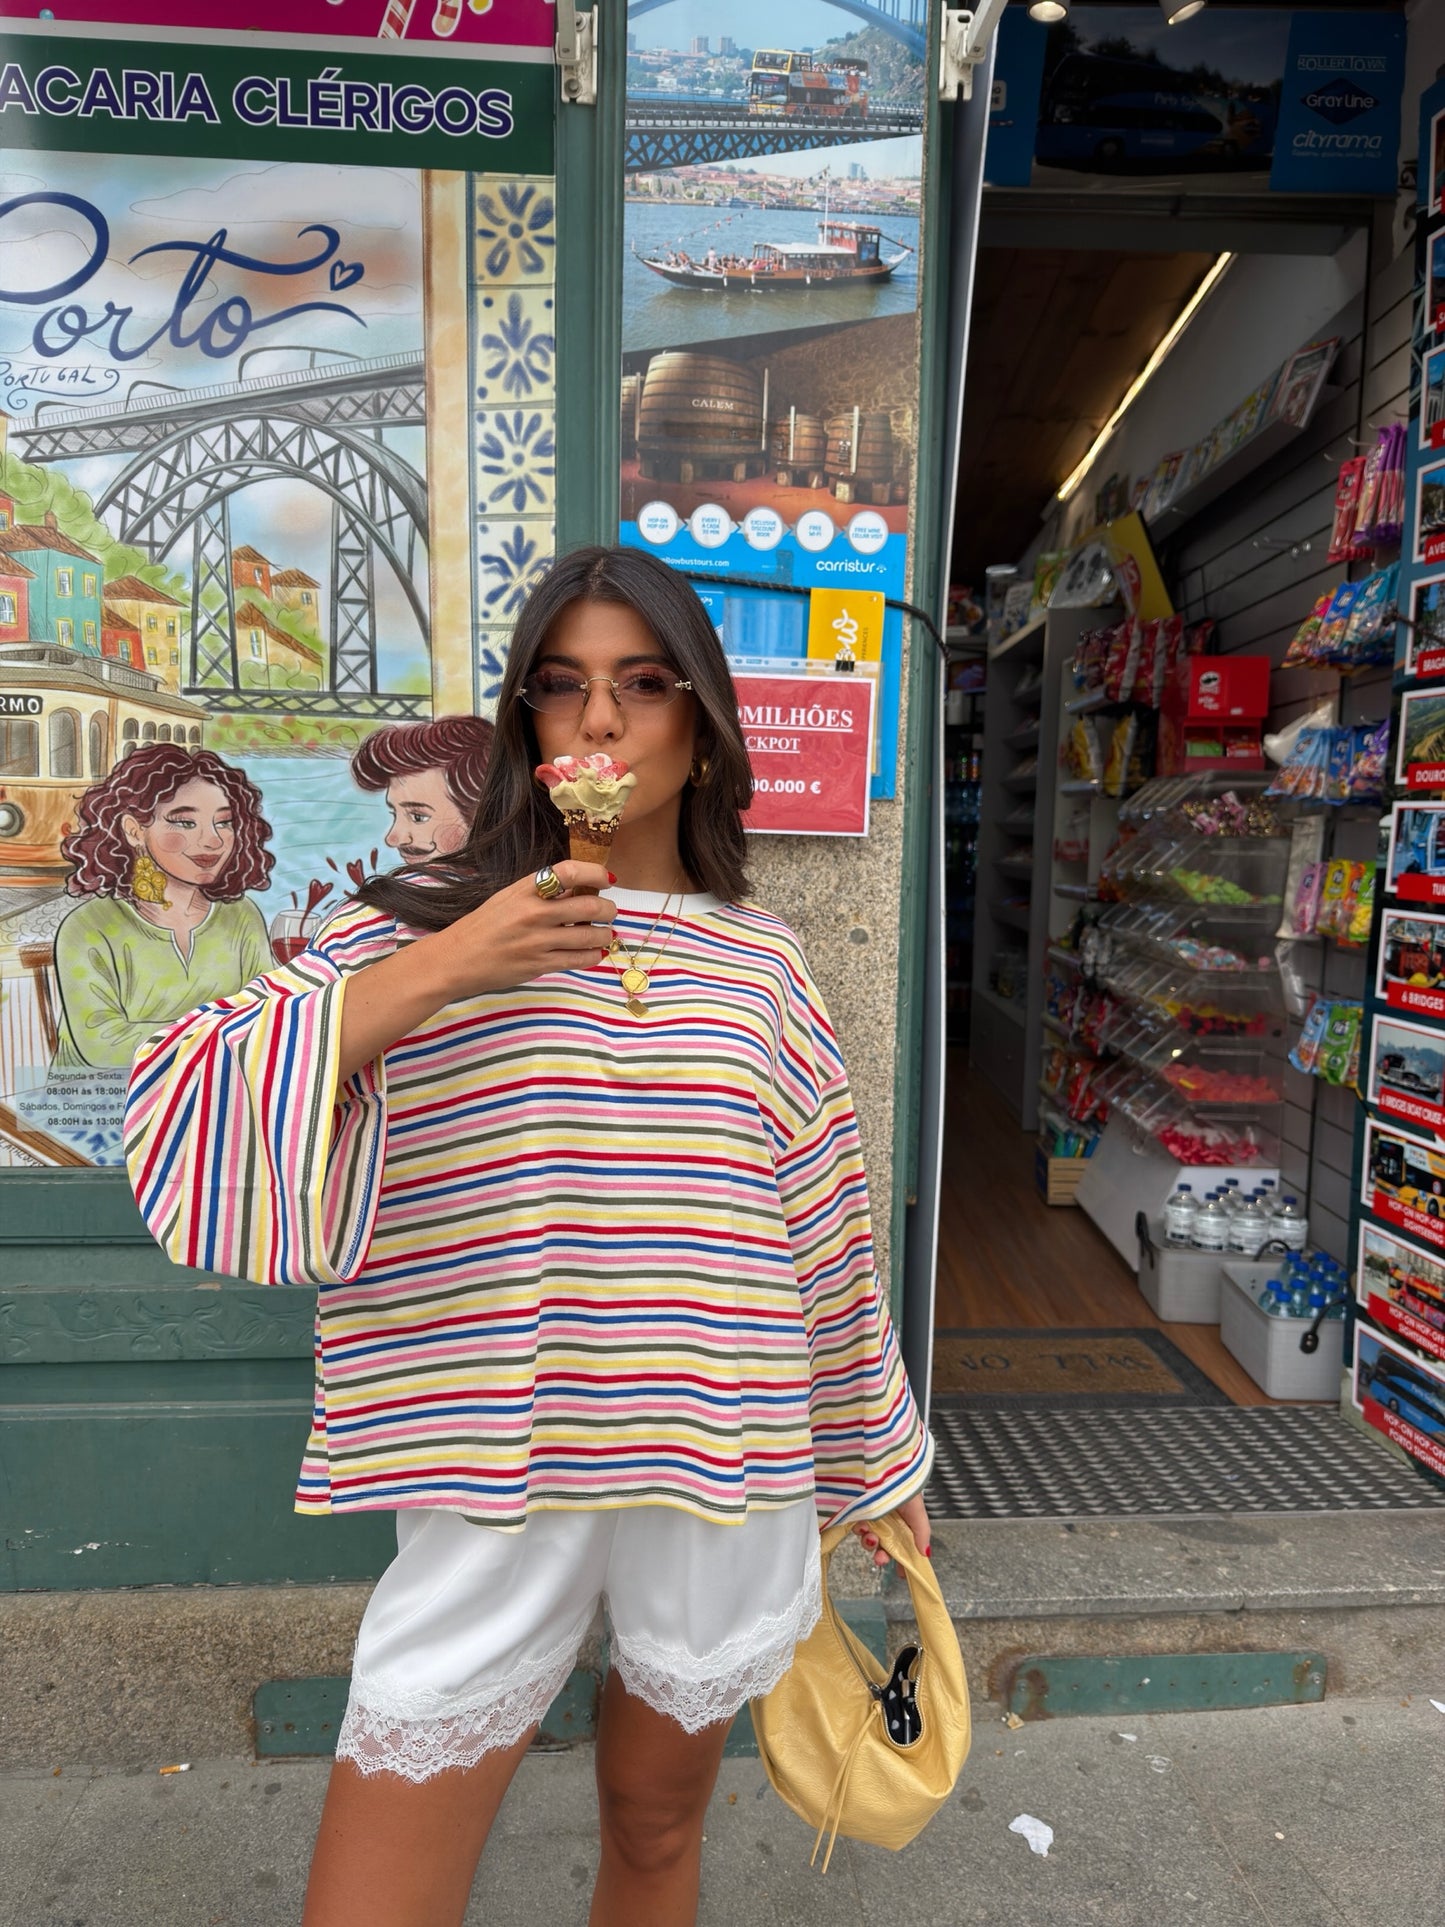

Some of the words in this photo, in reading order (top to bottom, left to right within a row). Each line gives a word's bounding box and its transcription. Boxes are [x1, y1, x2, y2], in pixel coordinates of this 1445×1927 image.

[233, 67, 515, 140] CLÉRIGOS
[1293, 129, 1383, 149] cityrama
[815, 559, 876, 573] carristur
[861, 626, 869, 662] PERIENCES
[737, 704, 853, 729] MILHÕES
[810, 780, 821, 794] €
[1408, 991, 1444, 1011] BRIDGES
[47, 1072, 89, 1082] Segunda
[46, 1087, 79, 1096] 08:00H
[80, 1086, 92, 1096] às
[95, 1087, 126, 1096] 18:00H
[62, 1102, 107, 1113] Domingos
[47, 1117, 80, 1126] 08:00H
[81, 1116, 93, 1126] às
[1383, 1410, 1413, 1439] HOP-ON
[1388, 1428, 1413, 1452] PORTO
